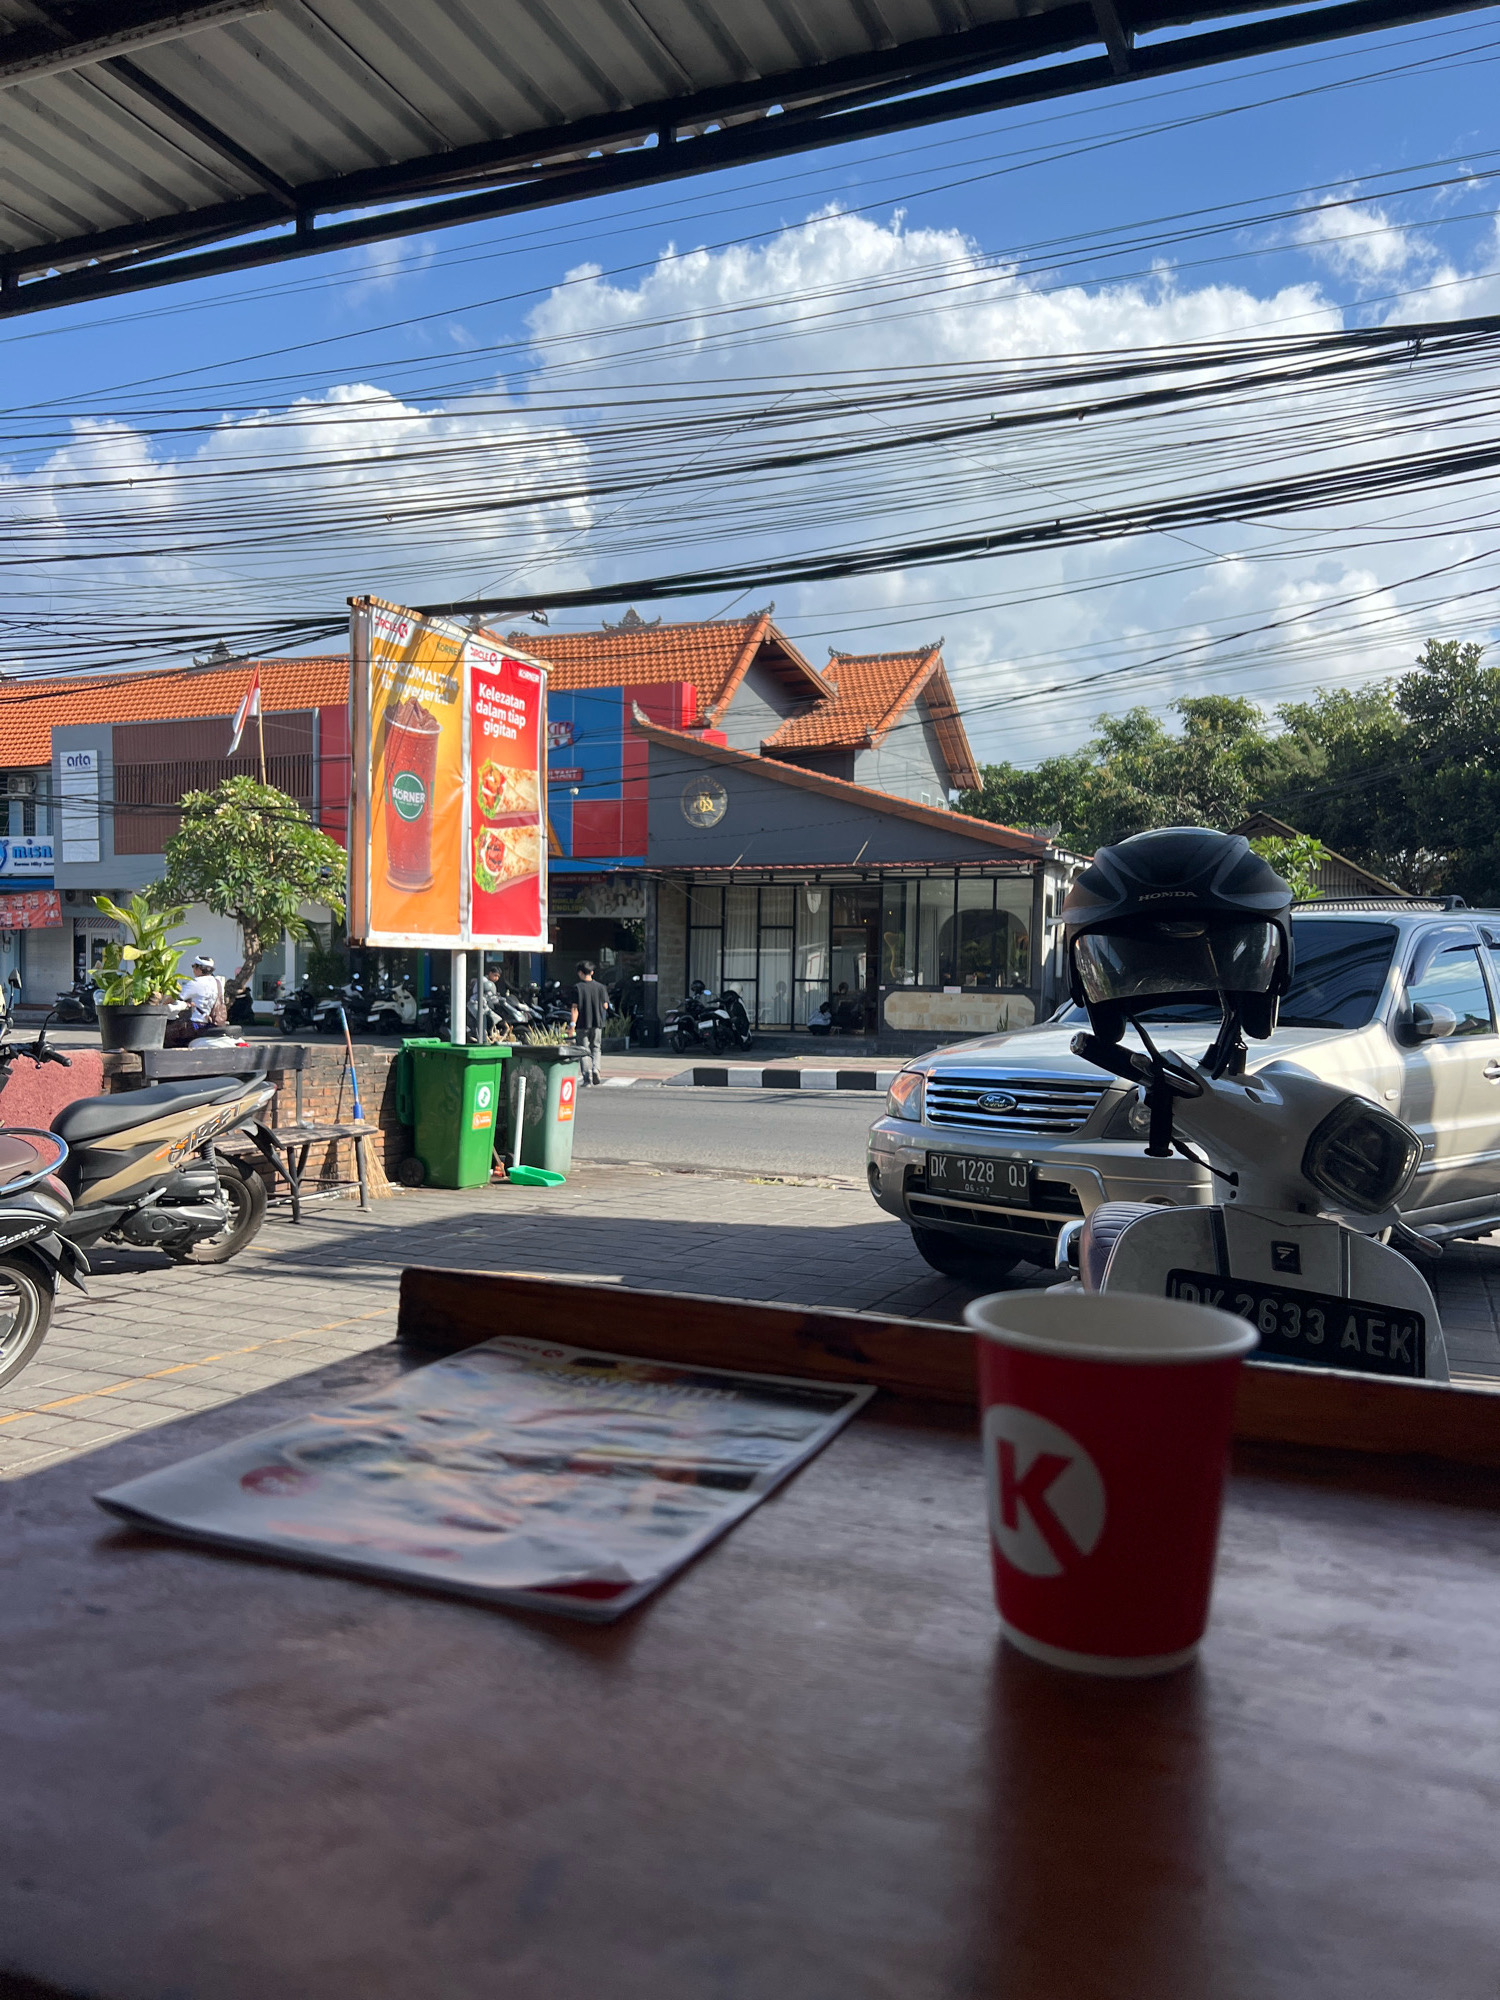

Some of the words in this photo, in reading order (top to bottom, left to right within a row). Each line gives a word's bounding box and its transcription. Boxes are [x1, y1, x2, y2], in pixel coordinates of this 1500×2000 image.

[479, 682, 525, 711] Kelezatan
[475, 699, 507, 721] dalam
[507, 709, 526, 729] tiap
[483, 718, 517, 740] gigitan
[67, 753, 91, 767] arta
[12, 838, 55, 858] misn
[1139, 891, 1198, 901] HONDA
[930, 1156, 947, 1178] DK
[959, 1160, 995, 1183] 1228
[1008, 1165, 1027, 1187] QJ
[1235, 1293, 1326, 1345] 2633
[1340, 1315, 1413, 1364] AEK
[995, 1435, 1091, 1573] K
